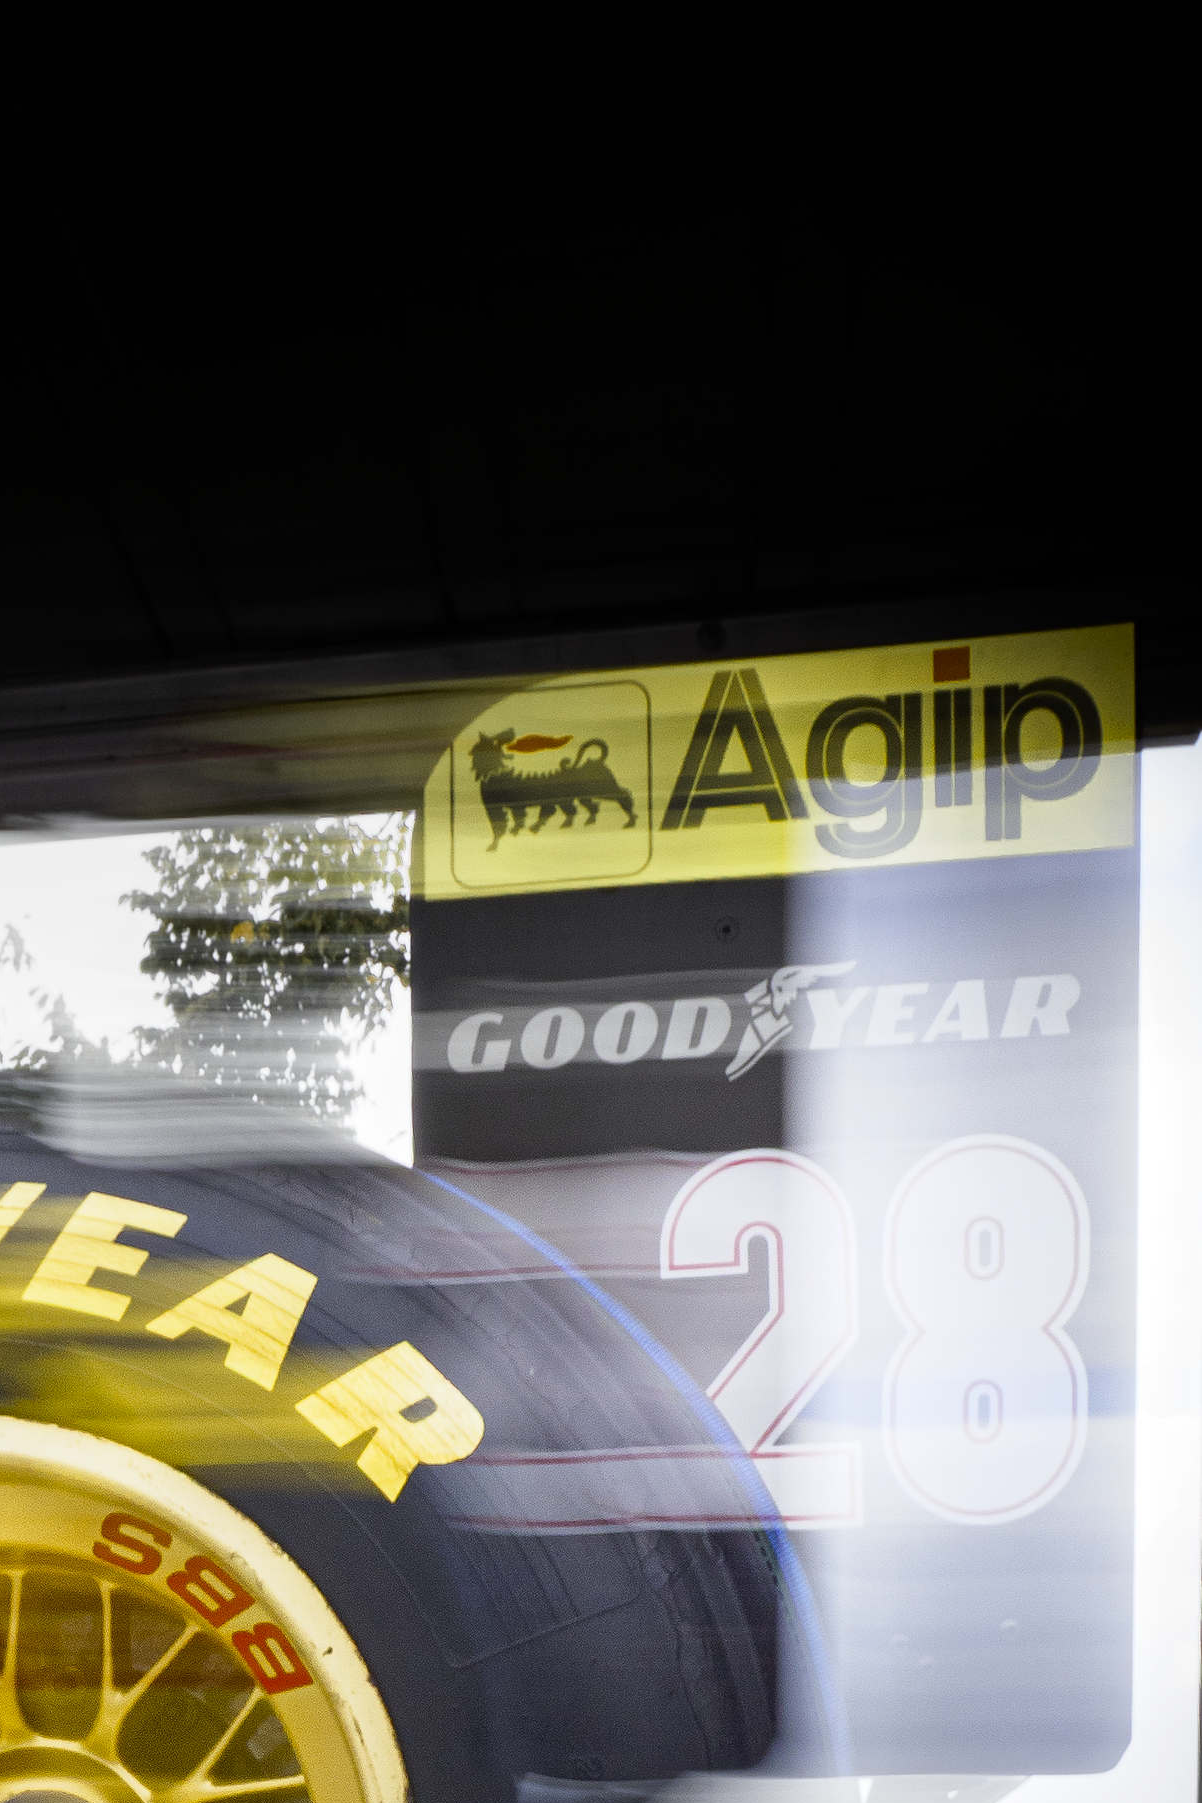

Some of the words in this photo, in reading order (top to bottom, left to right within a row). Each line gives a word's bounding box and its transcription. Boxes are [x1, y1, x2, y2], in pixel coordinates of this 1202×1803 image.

[659, 645, 1103, 859] Agip
[660, 1133, 1090, 1530] 28
[92, 1513, 313, 1695] BBS
